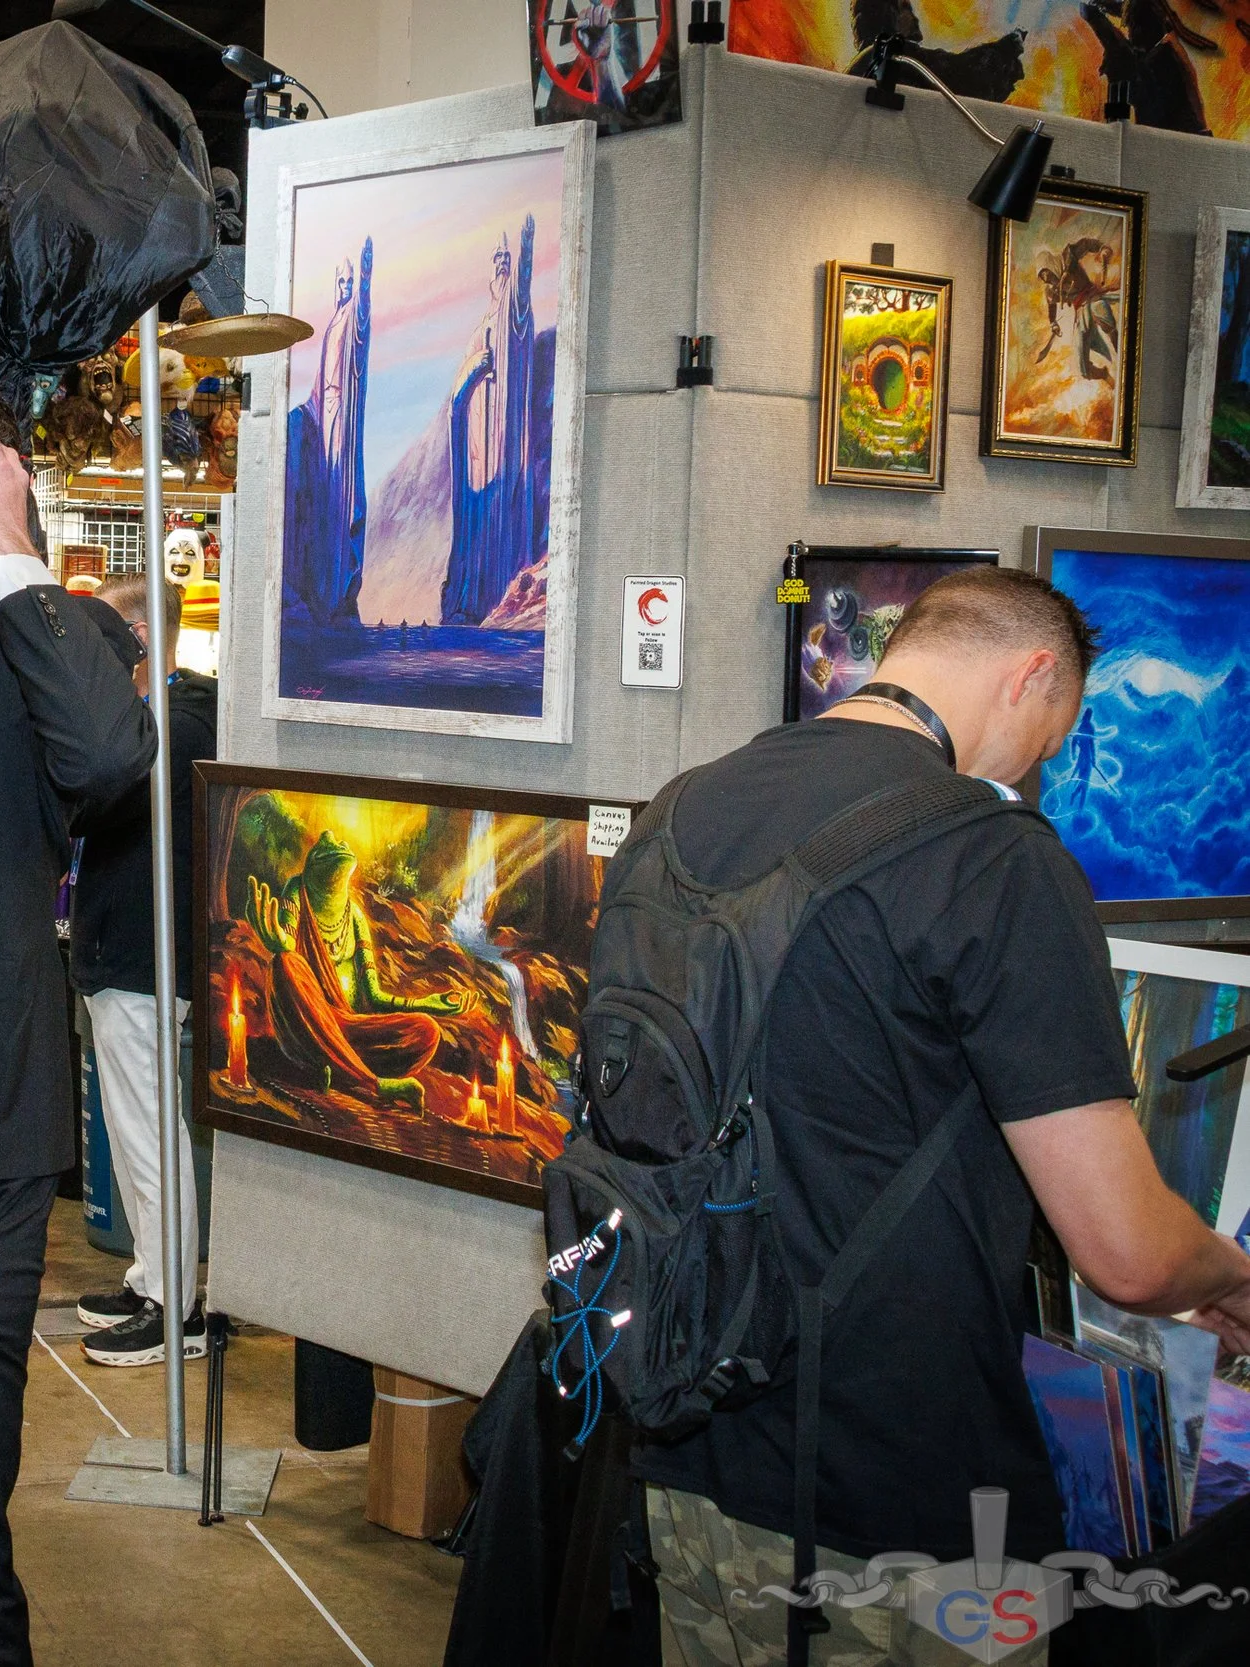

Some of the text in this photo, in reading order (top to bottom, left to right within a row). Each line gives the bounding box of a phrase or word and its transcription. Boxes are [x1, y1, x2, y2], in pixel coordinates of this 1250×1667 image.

[783, 578, 804, 587] GOD
[777, 595, 811, 603] DONUT!
[594, 808, 626, 820] Canvas
[593, 821, 625, 837] Shipping
[591, 835, 623, 848] Availab
[547, 1234, 606, 1277] RFUN
